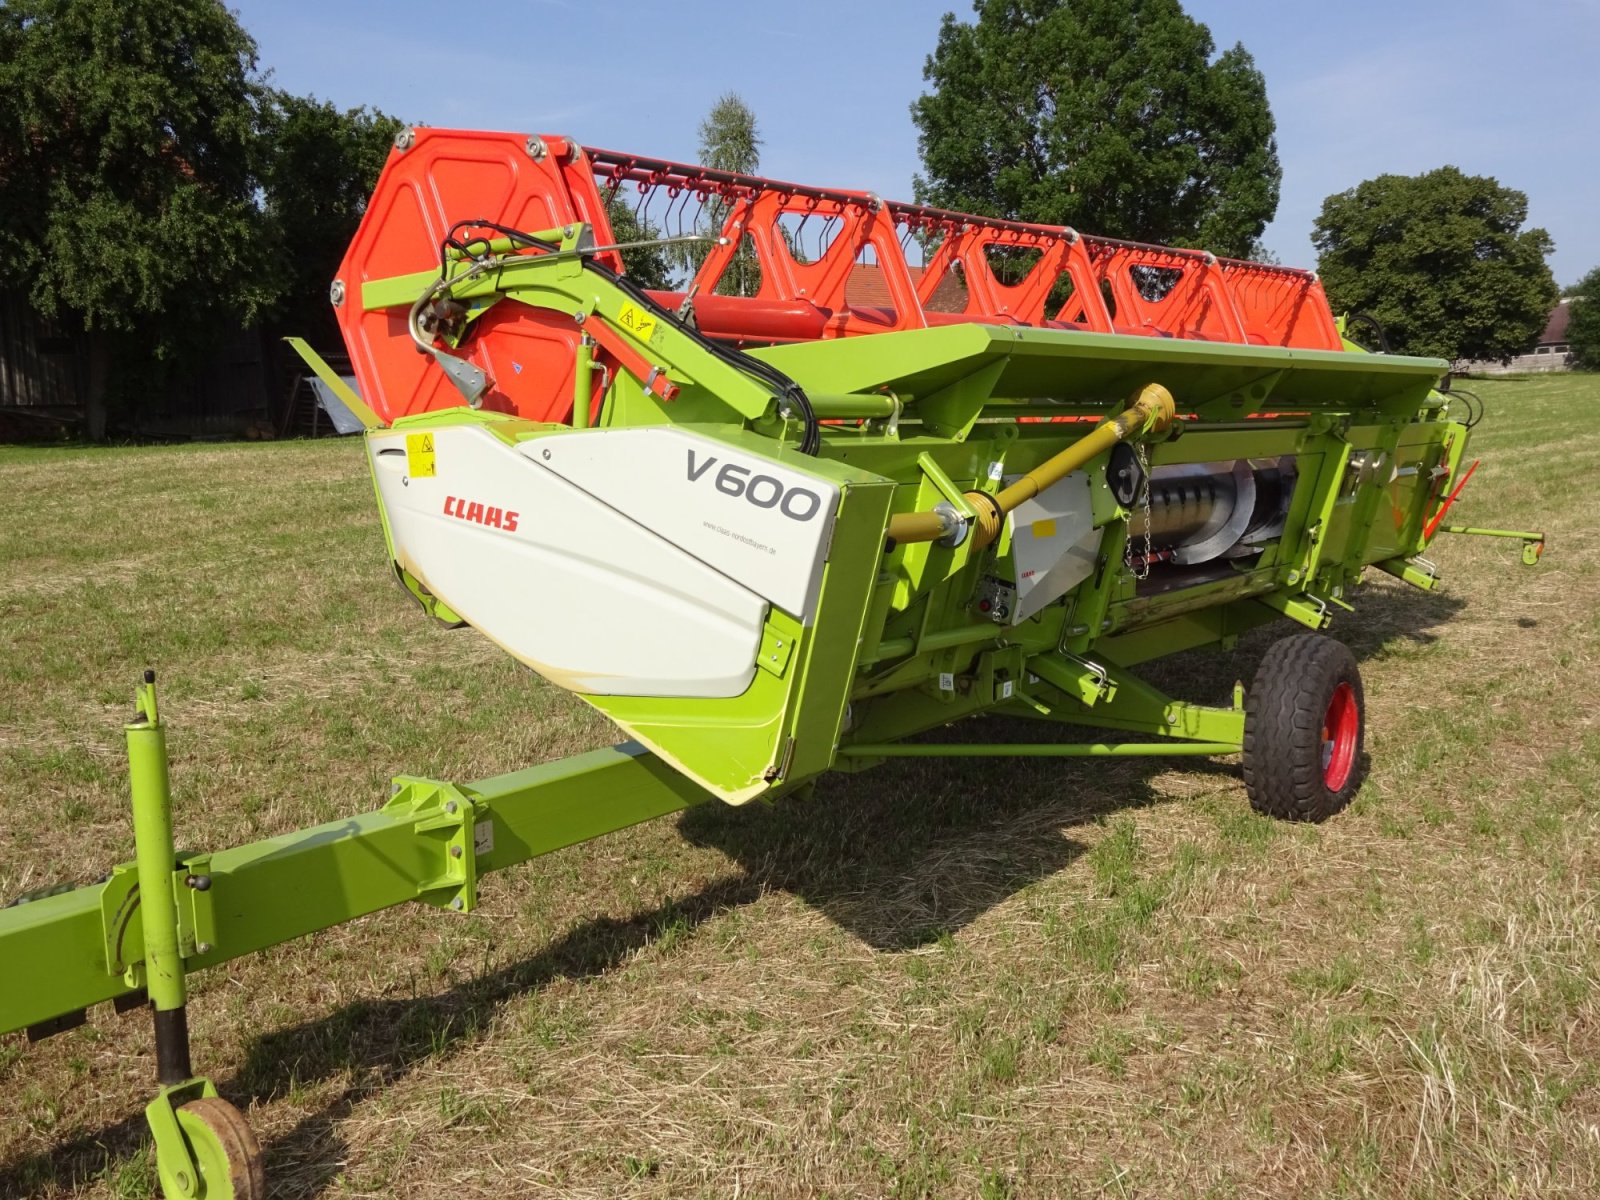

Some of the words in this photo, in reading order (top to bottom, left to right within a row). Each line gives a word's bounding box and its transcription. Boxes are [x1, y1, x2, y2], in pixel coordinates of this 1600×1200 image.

[688, 449, 717, 482] V
[715, 463, 821, 522] 600
[444, 496, 519, 532] CLAAS
